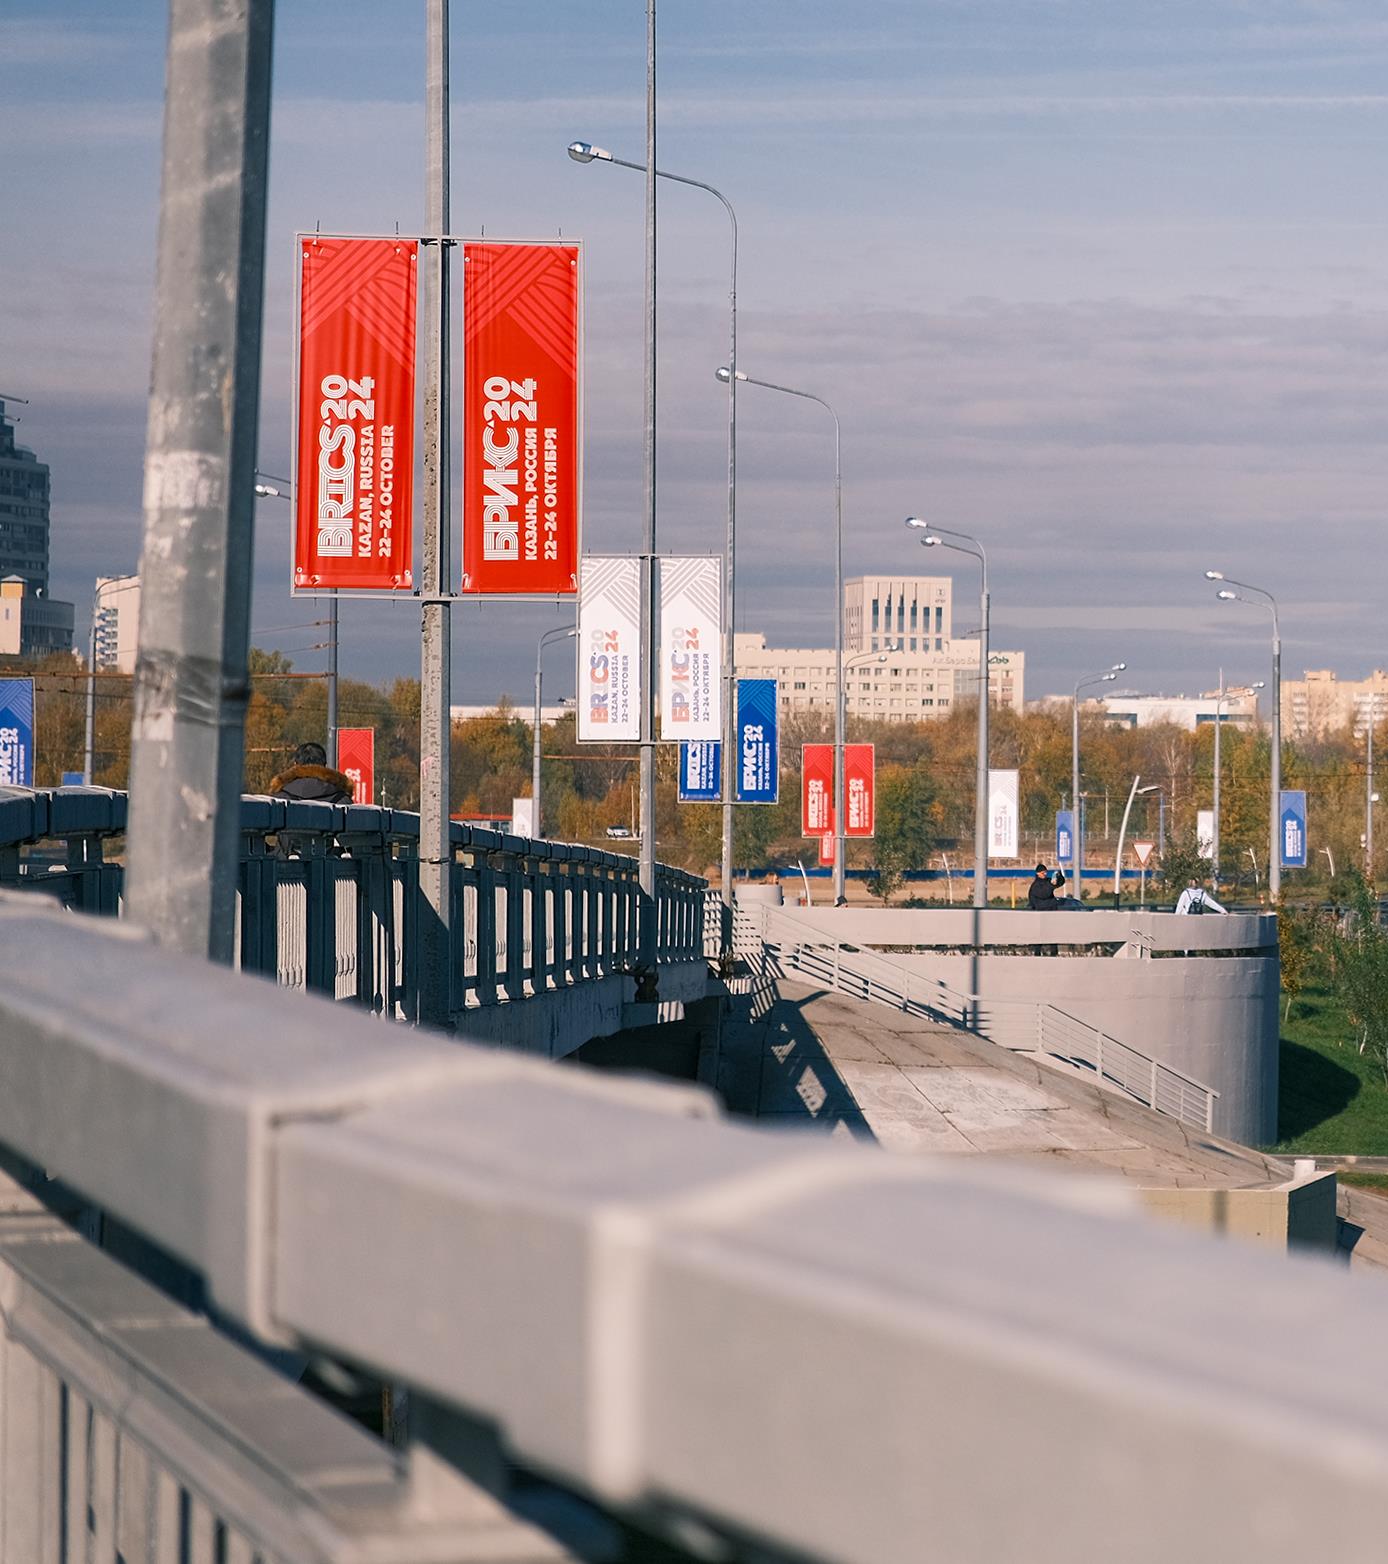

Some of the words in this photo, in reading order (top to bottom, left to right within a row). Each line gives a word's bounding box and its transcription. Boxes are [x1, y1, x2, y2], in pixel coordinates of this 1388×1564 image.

[348, 376, 376, 420] 24
[510, 378, 537, 422] 24
[359, 424, 374, 490] RUSSIA
[379, 424, 394, 506] OCTOBER
[524, 427, 538, 492] РОССИЯ
[544, 428, 557, 507] ОКТЯБРЯ
[317, 424, 356, 557] BRICS
[482, 427, 519, 561] БРИКС
[358, 493, 374, 557] KAZAN,
[525, 495, 538, 560] КАЗАНЬ,
[605, 630, 619, 652] 24
[685, 627, 700, 650] 24
[590, 654, 609, 723] BRICS
[611, 655, 619, 688] RUSSIA
[621, 655, 629, 696] OCTOBER
[671, 653, 690, 722] БРИКС
[702, 653, 710, 694] ОКТЯБРЯ
[611, 690, 619, 723] KAZAN,
[692, 688, 700, 722] КАЗАНЬ,
[743, 743, 757, 790] БРИКС
